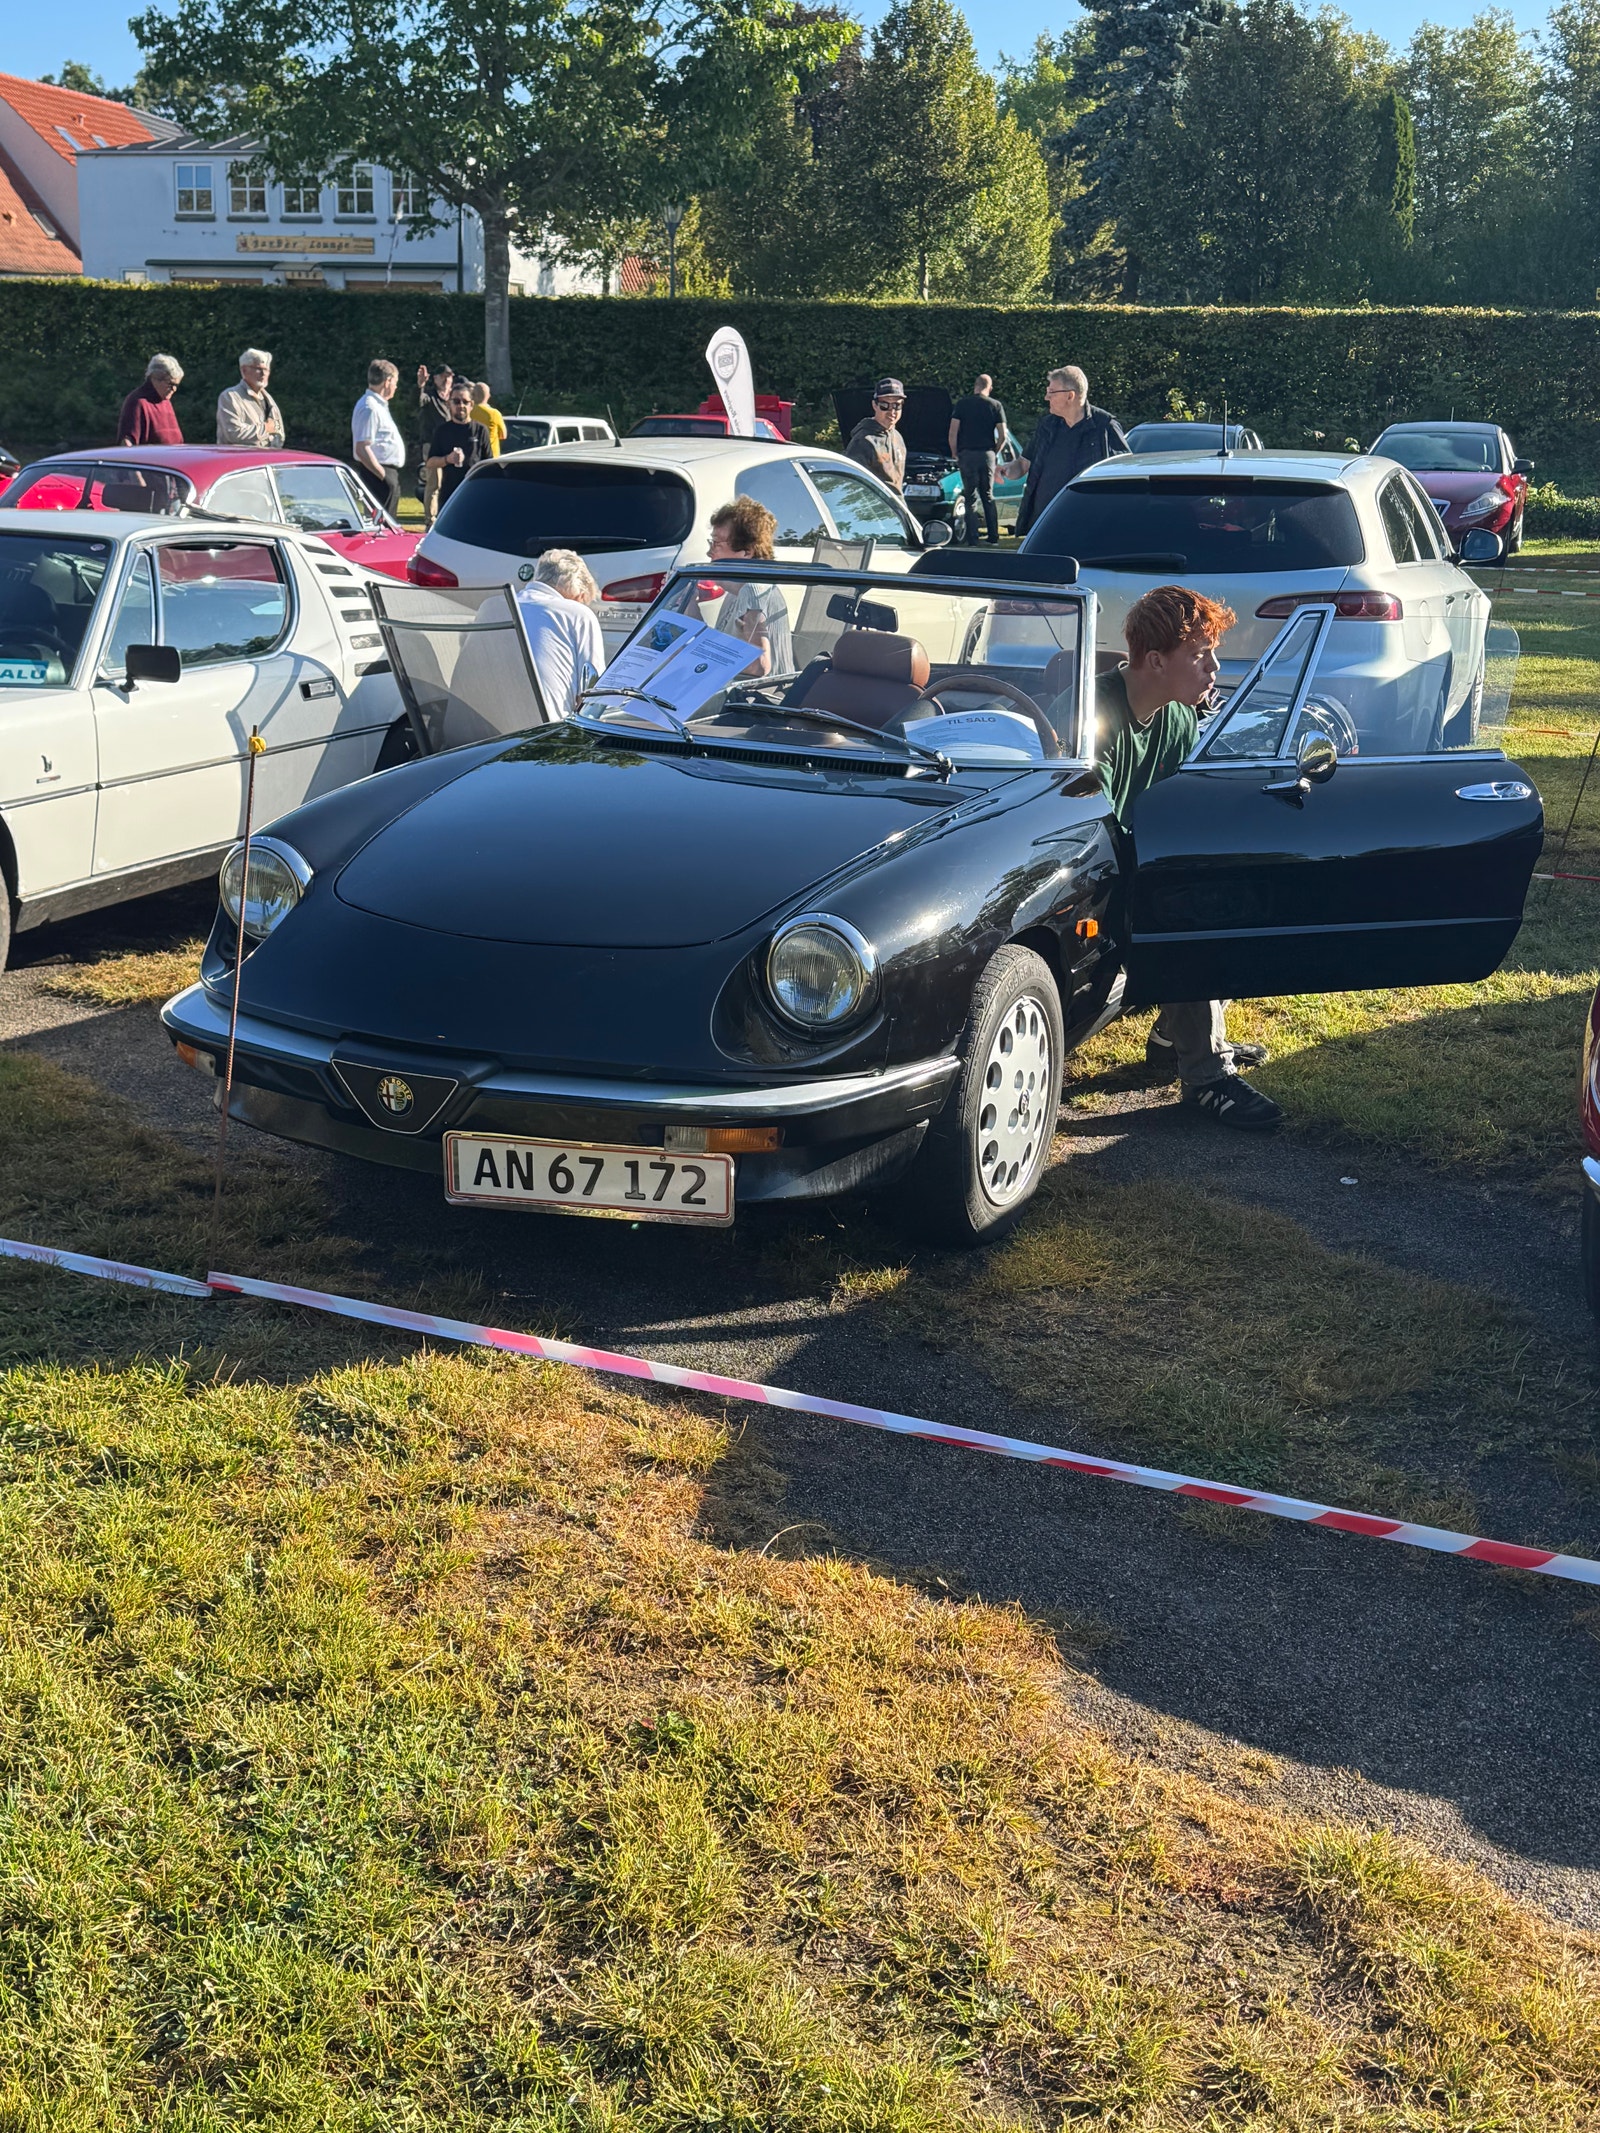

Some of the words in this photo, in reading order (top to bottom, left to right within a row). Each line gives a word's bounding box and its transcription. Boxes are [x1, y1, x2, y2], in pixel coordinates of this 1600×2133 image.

[391, 1077, 412, 1101] ROMEO
[473, 1148, 534, 1191] AN
[548, 1152, 604, 1196] 67
[624, 1160, 707, 1205] 172
